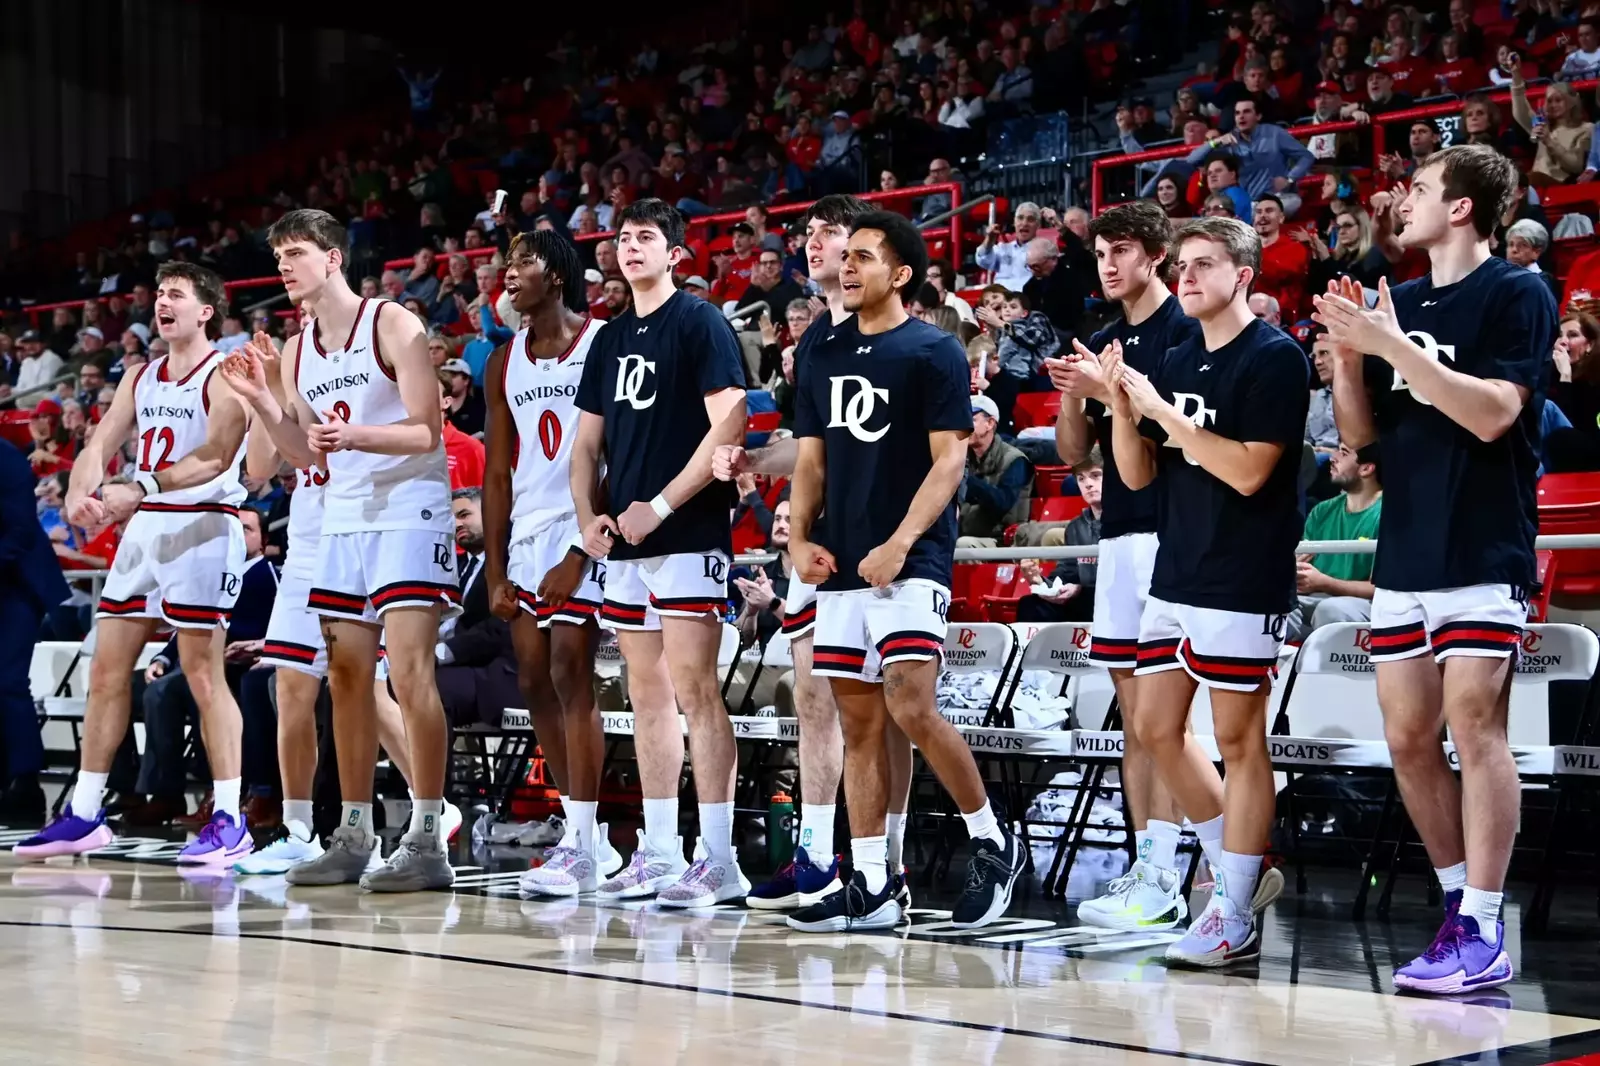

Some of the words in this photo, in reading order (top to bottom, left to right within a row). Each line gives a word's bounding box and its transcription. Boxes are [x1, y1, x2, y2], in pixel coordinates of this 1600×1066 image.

[306, 372, 370, 402] DAVIDSON
[514, 384, 580, 407] DAVIDSO
[613, 354, 658, 410] DC
[826, 375, 892, 443] DC
[138, 426, 175, 472] 12
[538, 409, 562, 462] 0
[431, 543, 454, 573] DC
[702, 555, 726, 585] DC
[219, 572, 240, 597] DC
[957, 628, 977, 649] DC
[1070, 627, 1091, 649] DC
[942, 649, 987, 660] AVIDSON
